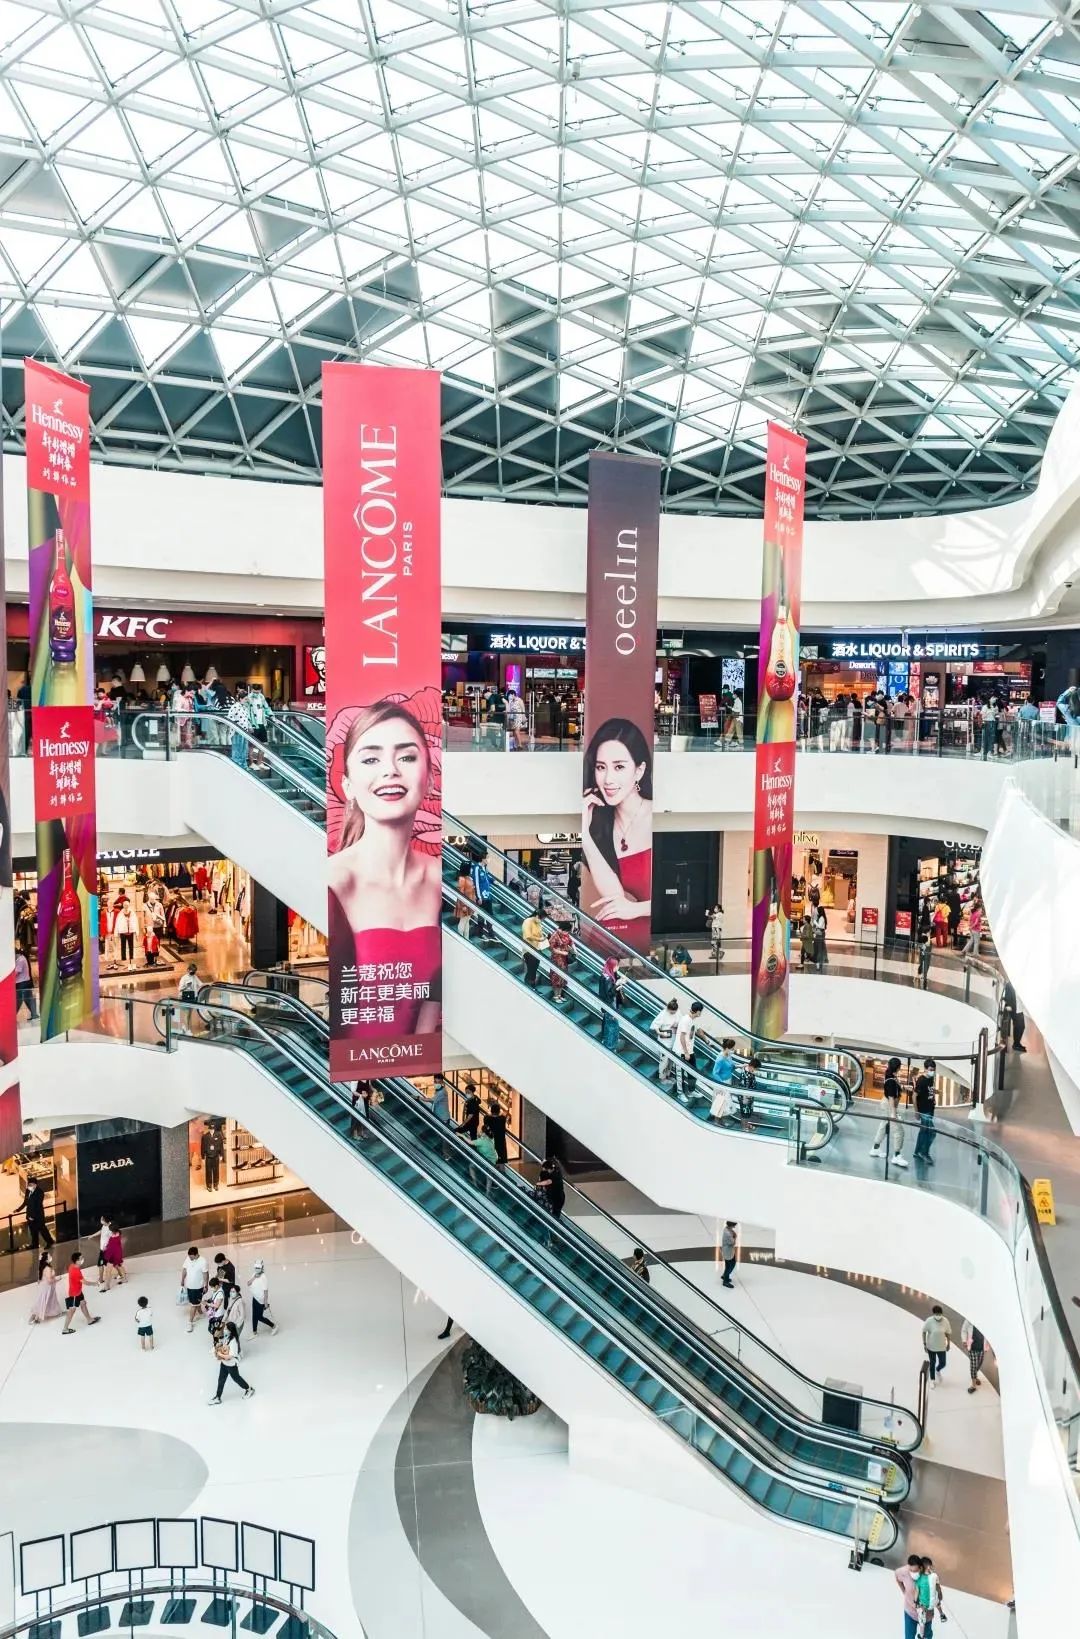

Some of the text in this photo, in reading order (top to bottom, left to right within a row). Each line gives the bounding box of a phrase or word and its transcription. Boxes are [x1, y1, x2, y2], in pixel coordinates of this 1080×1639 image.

[32, 403, 84, 444] Hennessy
[769, 462, 802, 495] Hennessy
[353, 423, 398, 668] LANCÔME
[402, 521, 413, 577] PARIS
[97, 615, 169, 639] KFC
[490, 633, 516, 649] 酒水
[518, 635, 568, 651] LIQUOR
[569, 637, 582, 650] &
[832, 642, 980, 658] 酒水 LIQUOR & SPIRITS
[40, 738, 90, 757] Hennessy
[761, 773, 793, 790] Hennessy
[340, 962, 413, 983] 兰蔻祝您
[340, 982, 430, 1004] 新年更美丽
[340, 1005, 395, 1026] 更幸福
[349, 1044, 423, 1062] LANCÔME
[91, 1157, 135, 1173] PRADA
